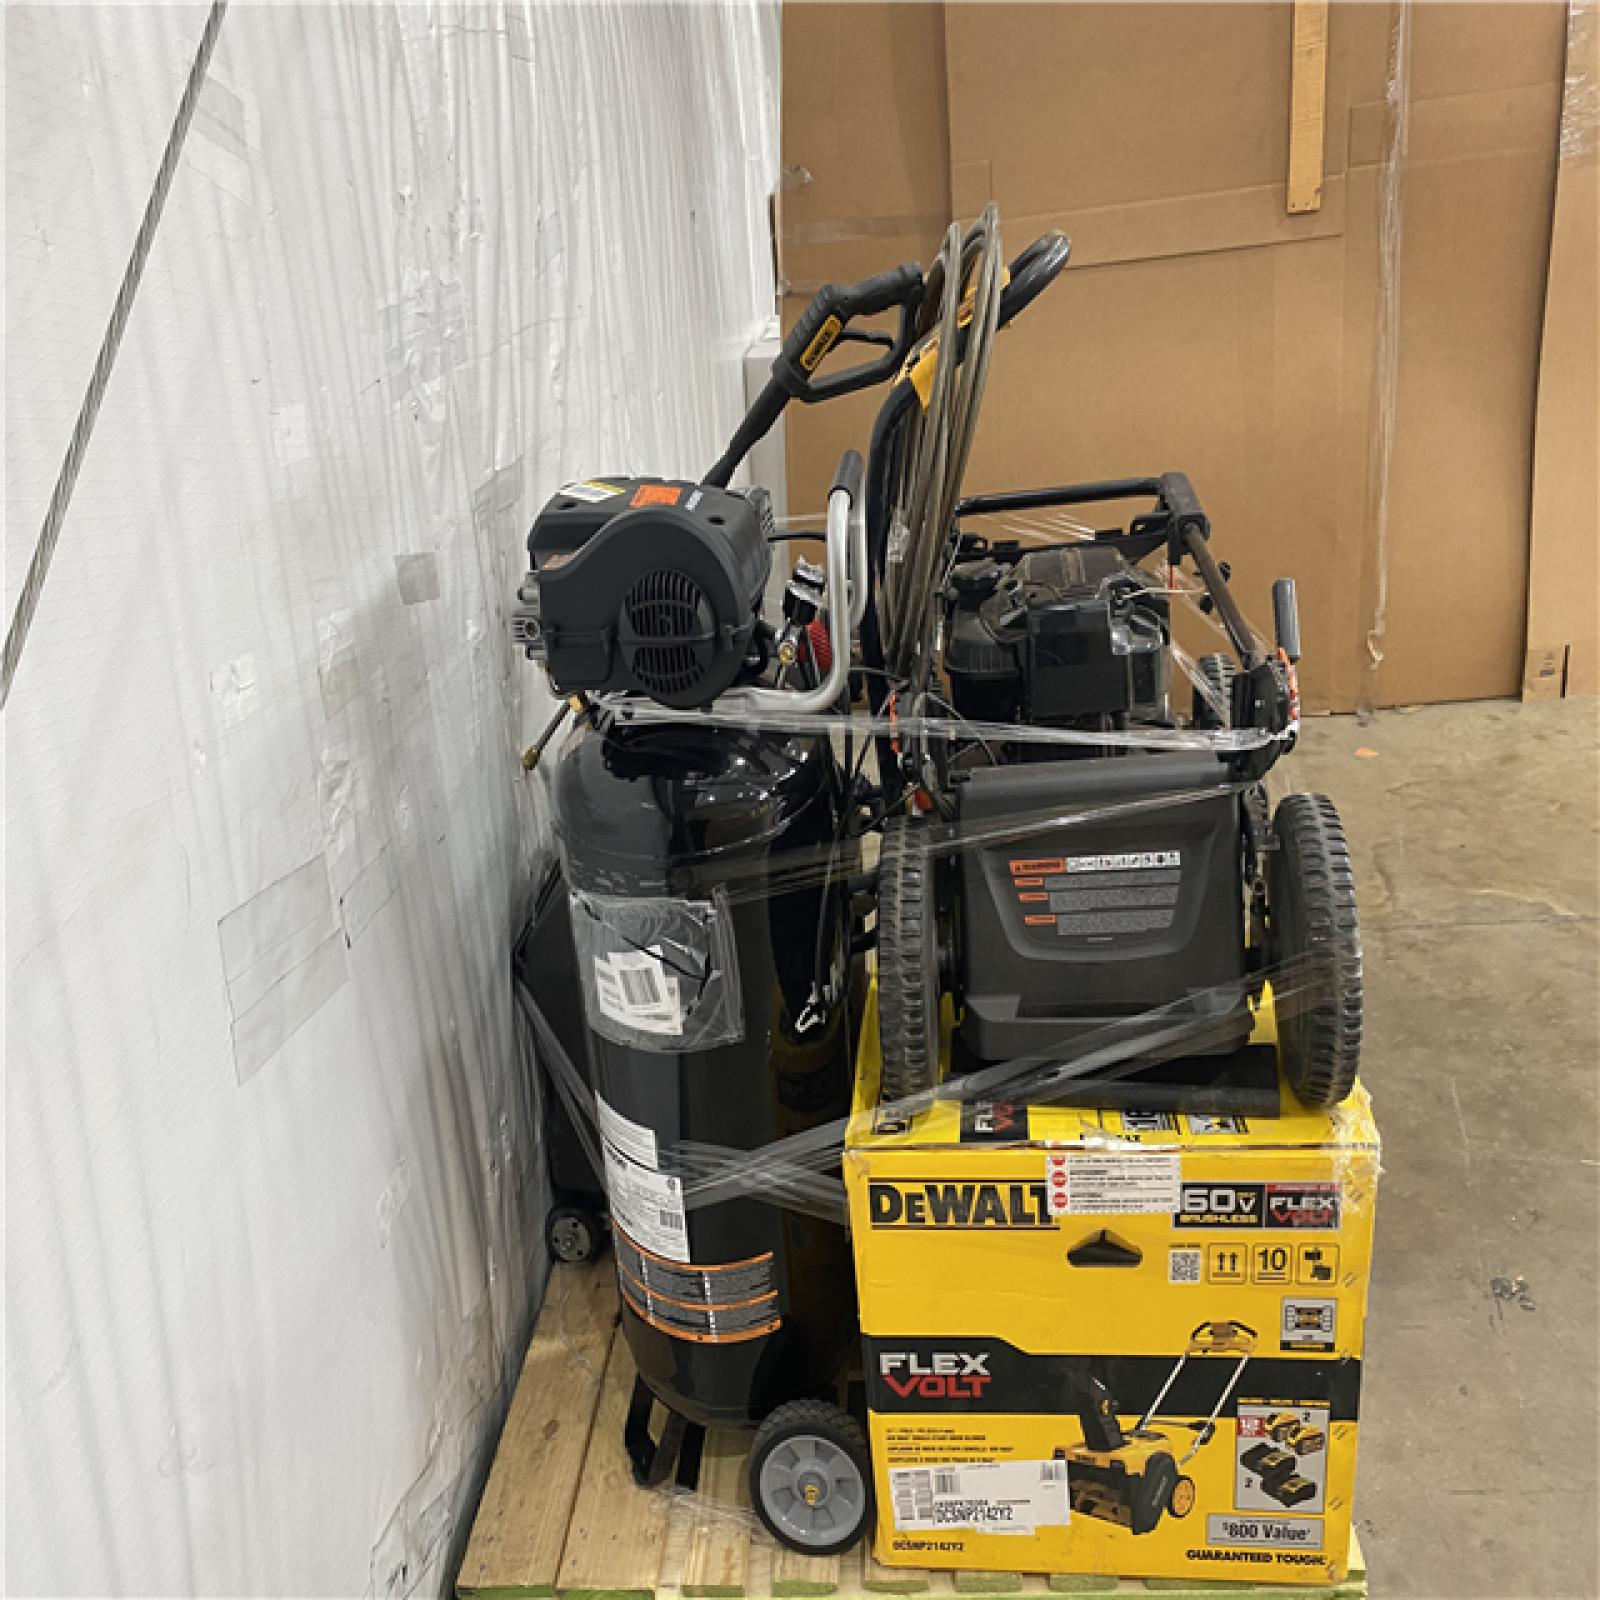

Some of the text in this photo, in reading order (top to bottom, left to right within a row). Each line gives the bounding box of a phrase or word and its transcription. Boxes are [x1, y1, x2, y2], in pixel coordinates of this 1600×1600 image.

[869, 1184, 1054, 1223] DEWALT
[1269, 1196, 1334, 1211] FLEX
[1271, 1210, 1332, 1224] VOLT
[1258, 1248, 1288, 1271] 10
[879, 1352, 991, 1375] FLEX
[881, 1375, 992, 1398] VOLT
[1185, 1548, 1274, 1563] GUARANTEED
